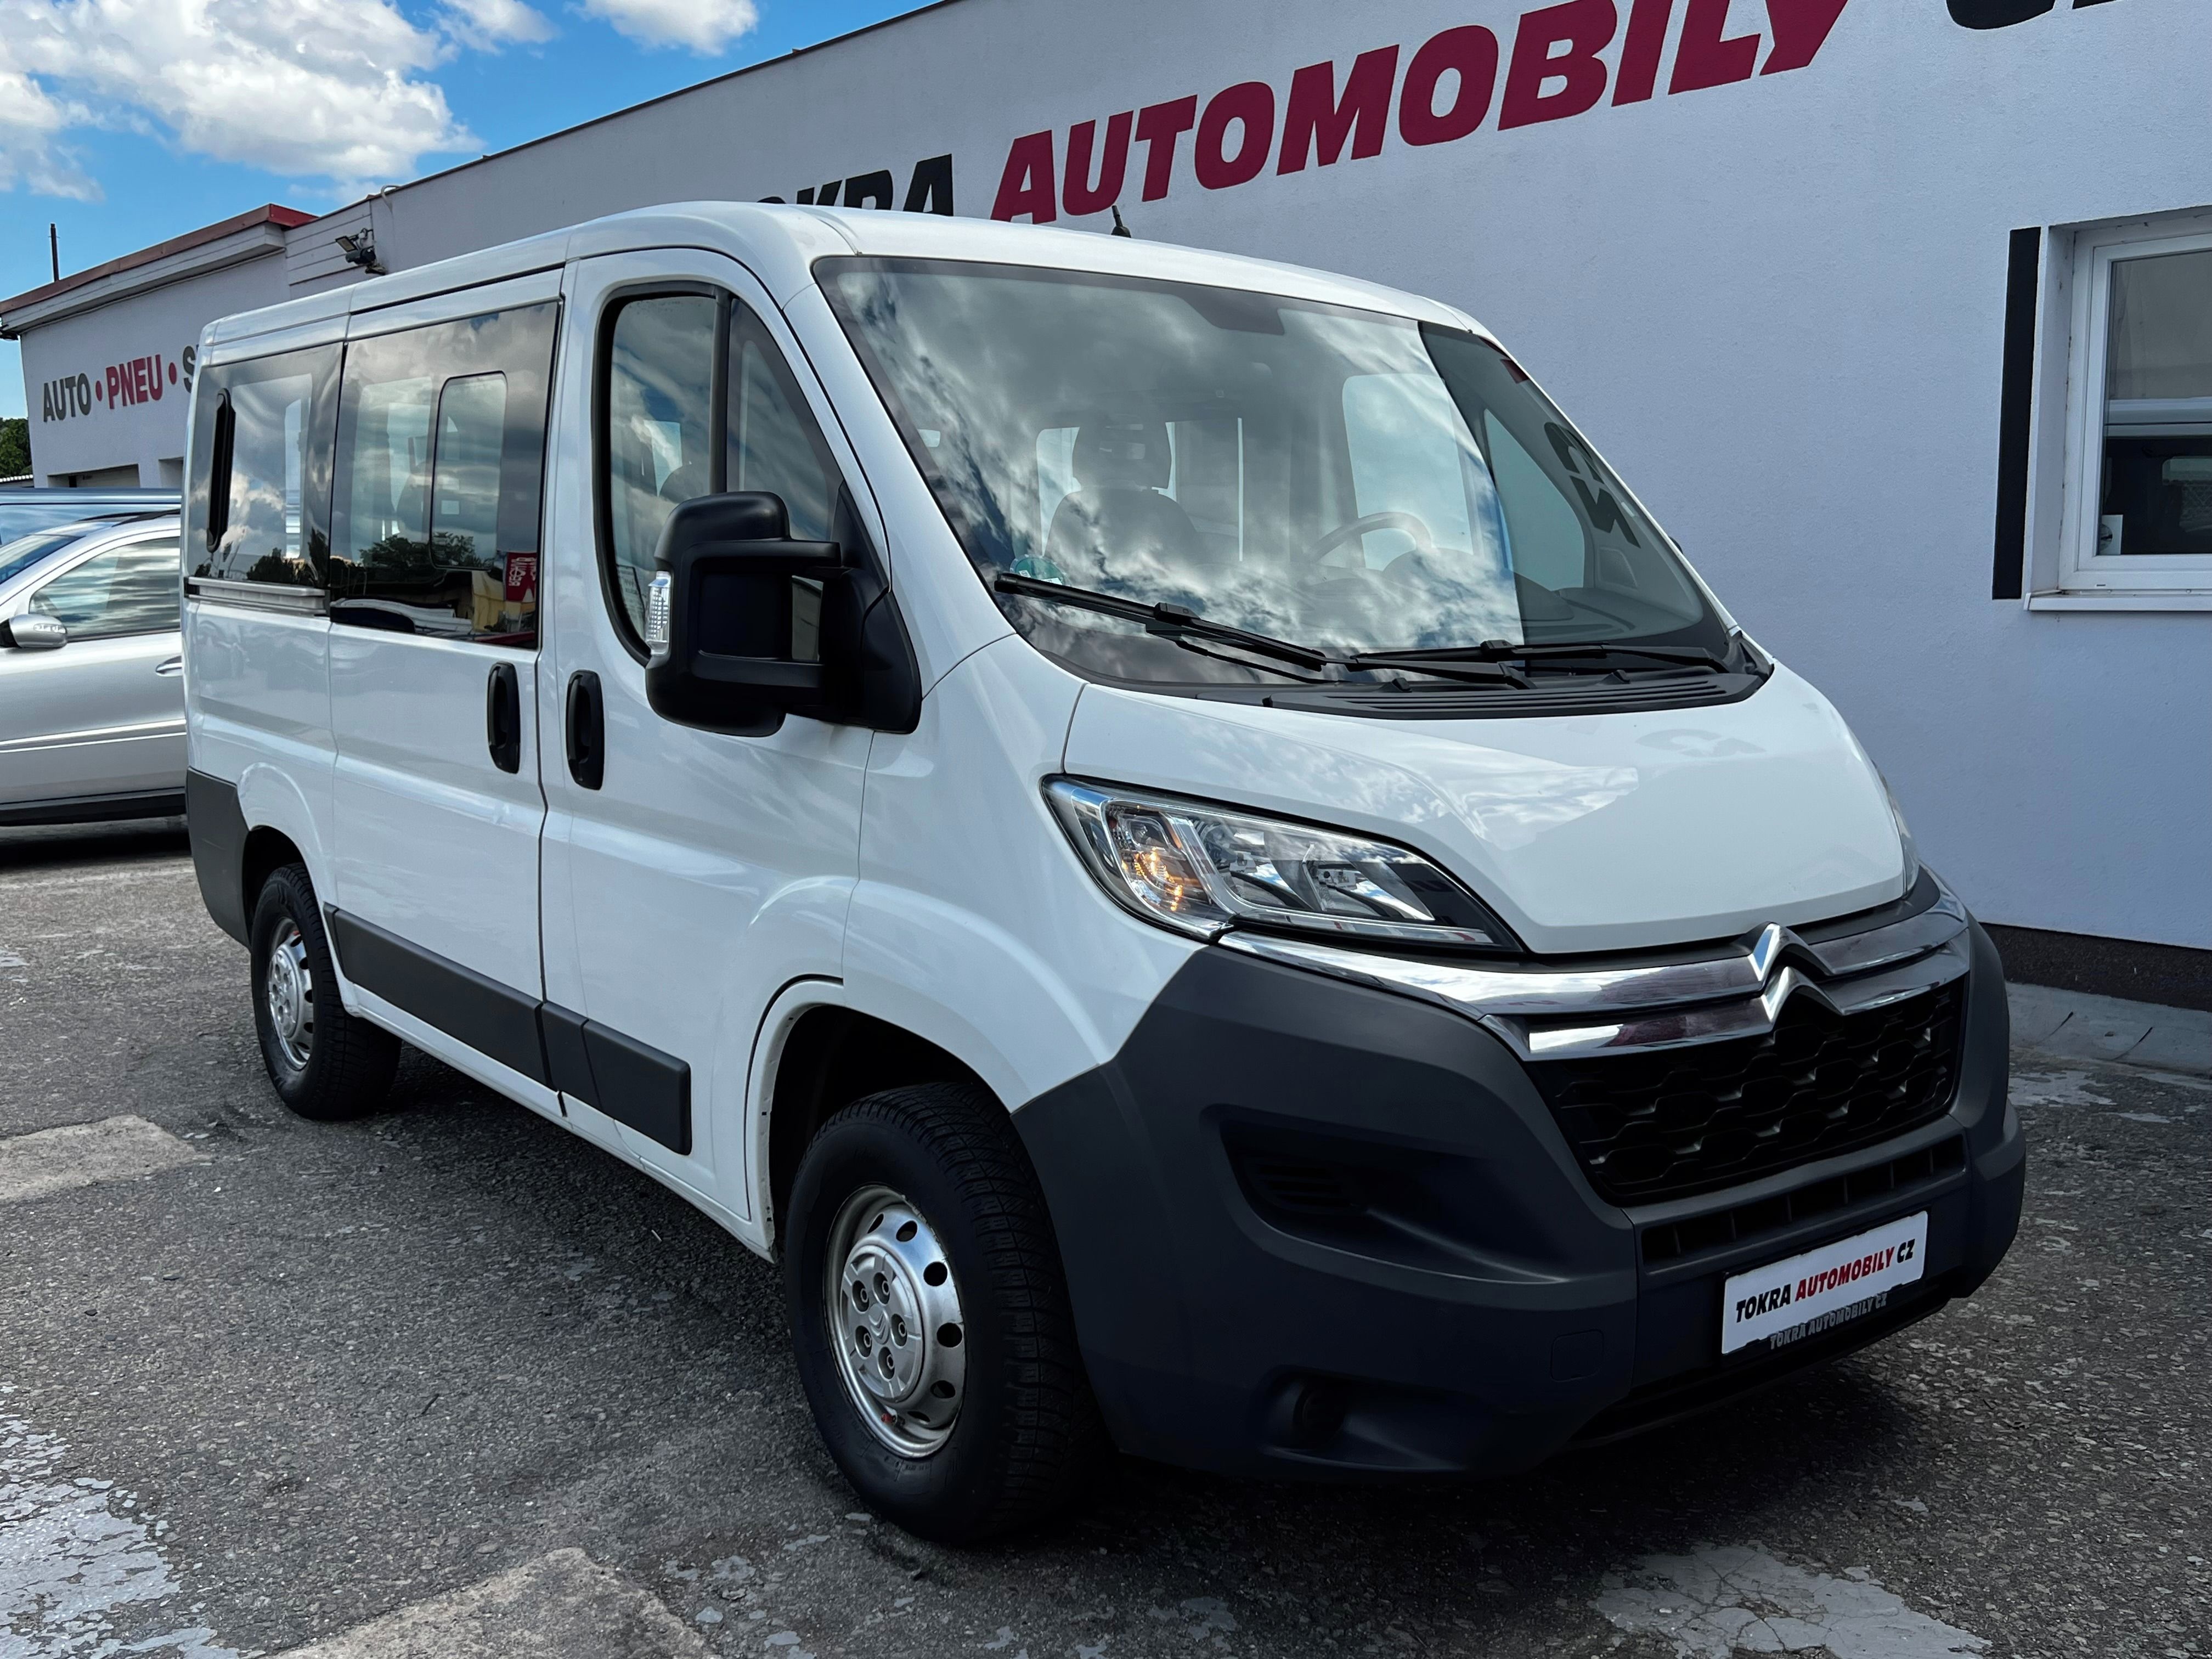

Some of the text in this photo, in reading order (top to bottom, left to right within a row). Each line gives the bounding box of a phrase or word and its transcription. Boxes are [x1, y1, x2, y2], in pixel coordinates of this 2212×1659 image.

[43, 373, 92, 422] AUTO
[105, 354, 163, 409] PNEU
[1736, 1238, 1915, 1323] TOKRA AUTOMOBILY CZ
[1770, 1293, 1888, 1350] TOKRA AUTOMOBILY CZ
